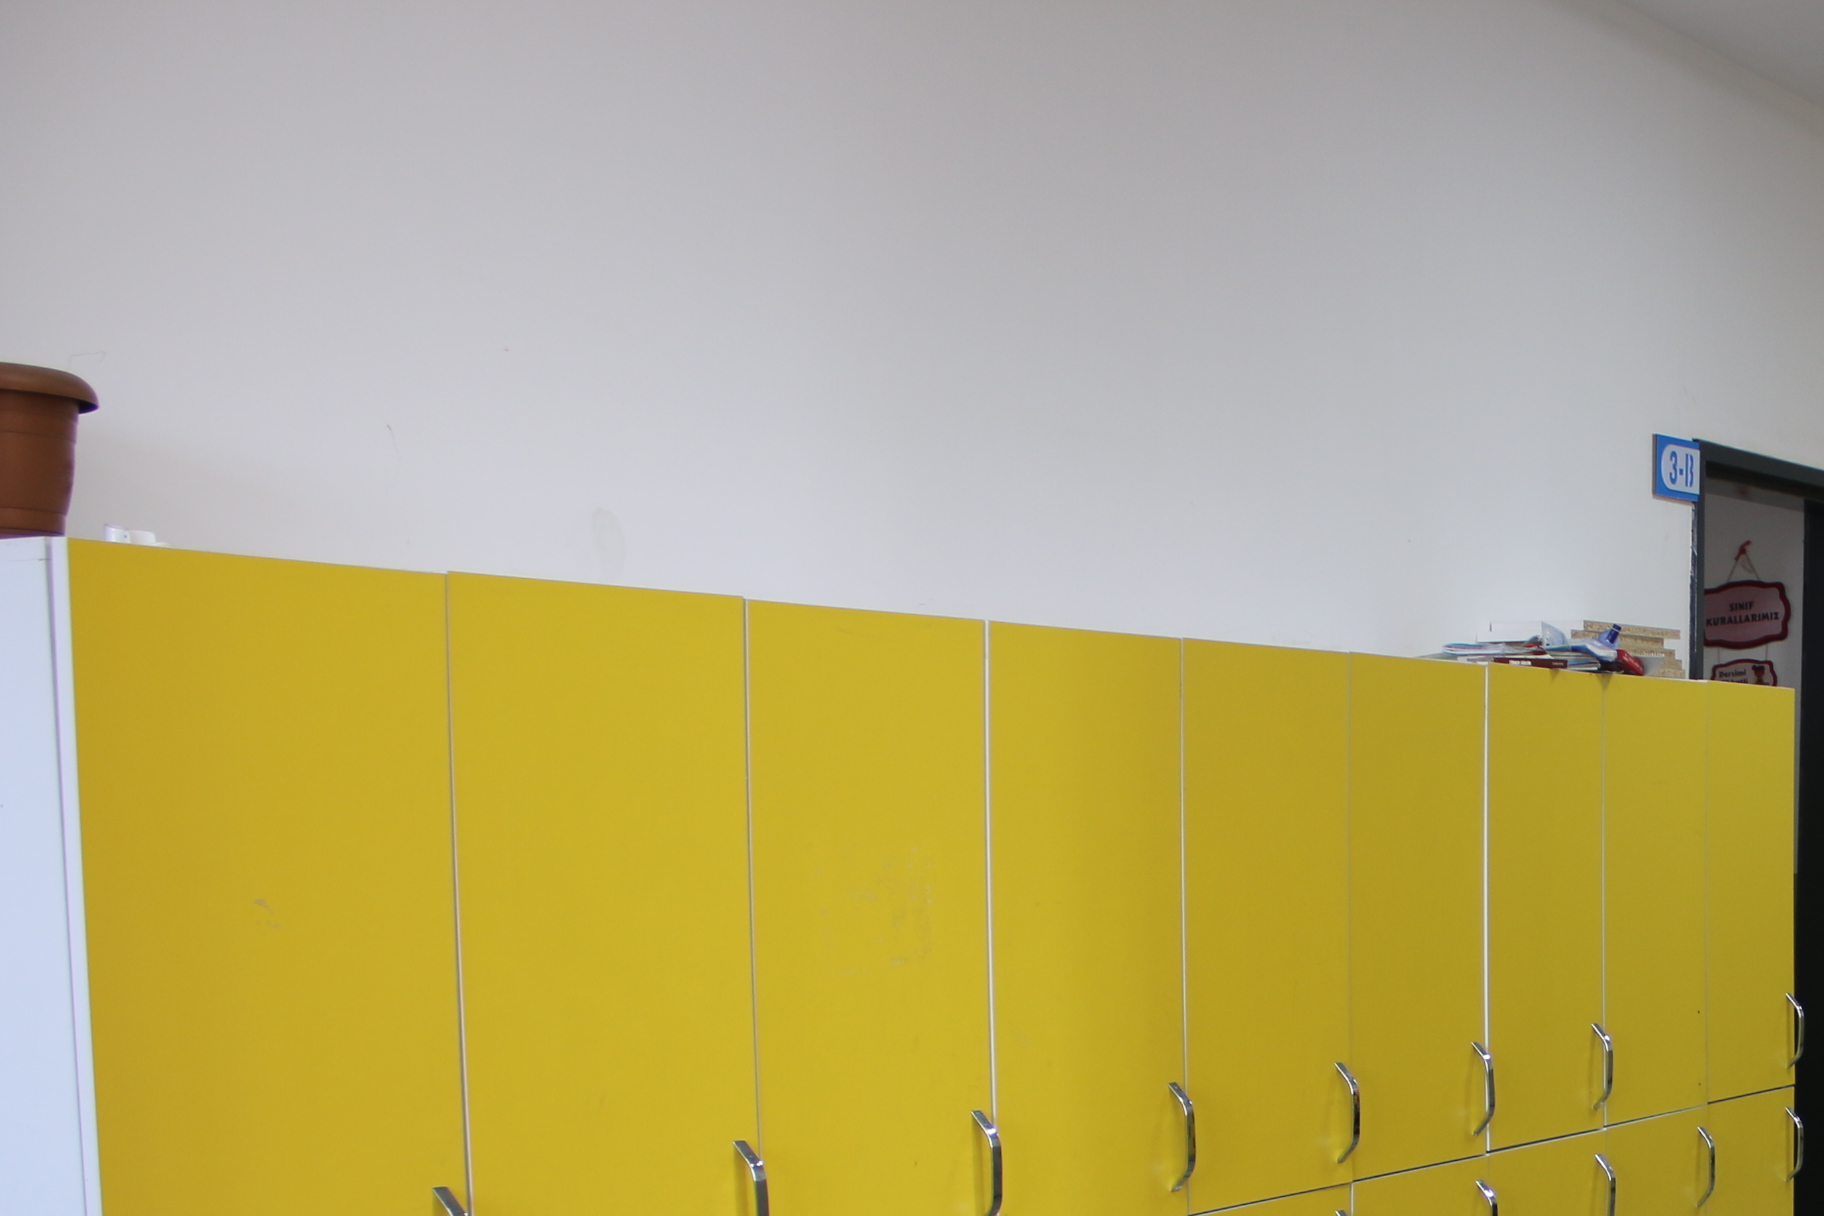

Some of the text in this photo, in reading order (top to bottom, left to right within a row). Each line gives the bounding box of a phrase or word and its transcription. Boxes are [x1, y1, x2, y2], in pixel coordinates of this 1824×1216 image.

[1669, 450, 1694, 487] 3-B
[1729, 601, 1754, 612] SINIF
[1706, 611, 1779, 627] KURALLARIMIZ
